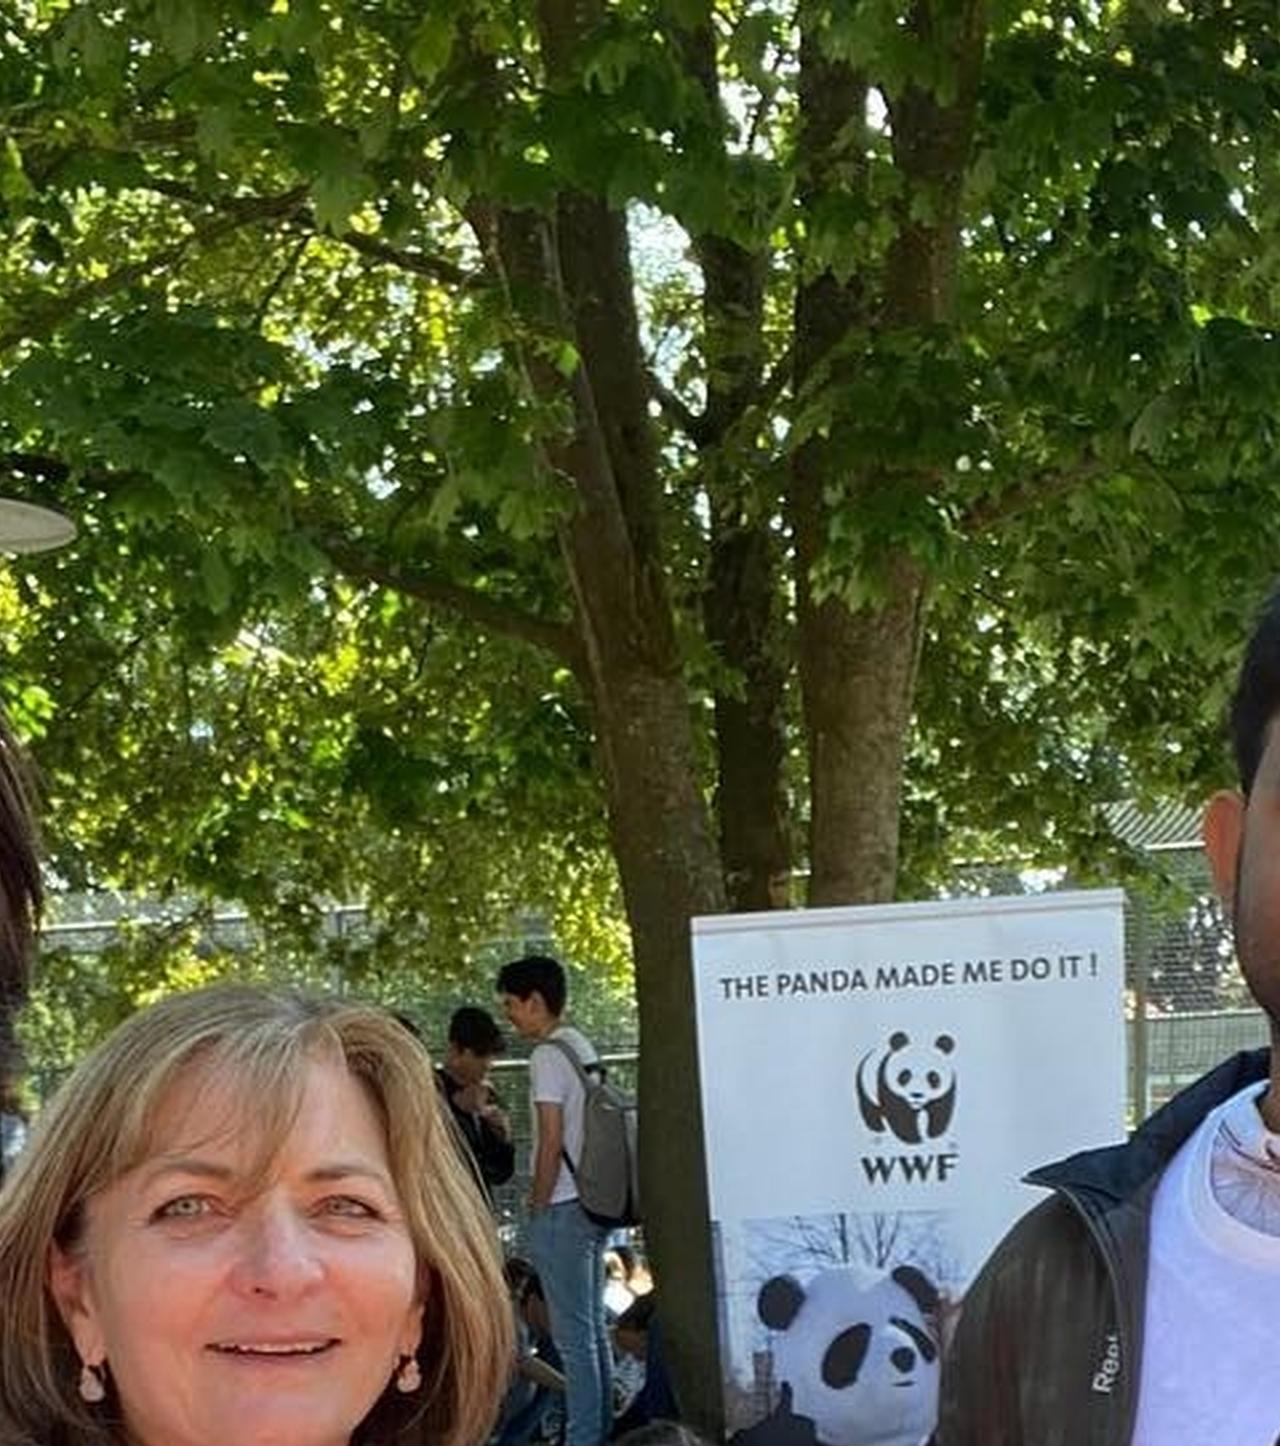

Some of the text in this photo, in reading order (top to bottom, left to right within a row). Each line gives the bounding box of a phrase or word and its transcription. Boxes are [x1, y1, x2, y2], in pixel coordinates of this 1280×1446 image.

[721, 976, 768, 999] THE
[777, 968, 867, 995] PANDA
[875, 962, 954, 990] MADE
[963, 958, 1003, 983] ME
[1011, 956, 1051, 980] DO
[1059, 954, 1082, 978] IT
[861, 1153, 959, 1184] WWF
